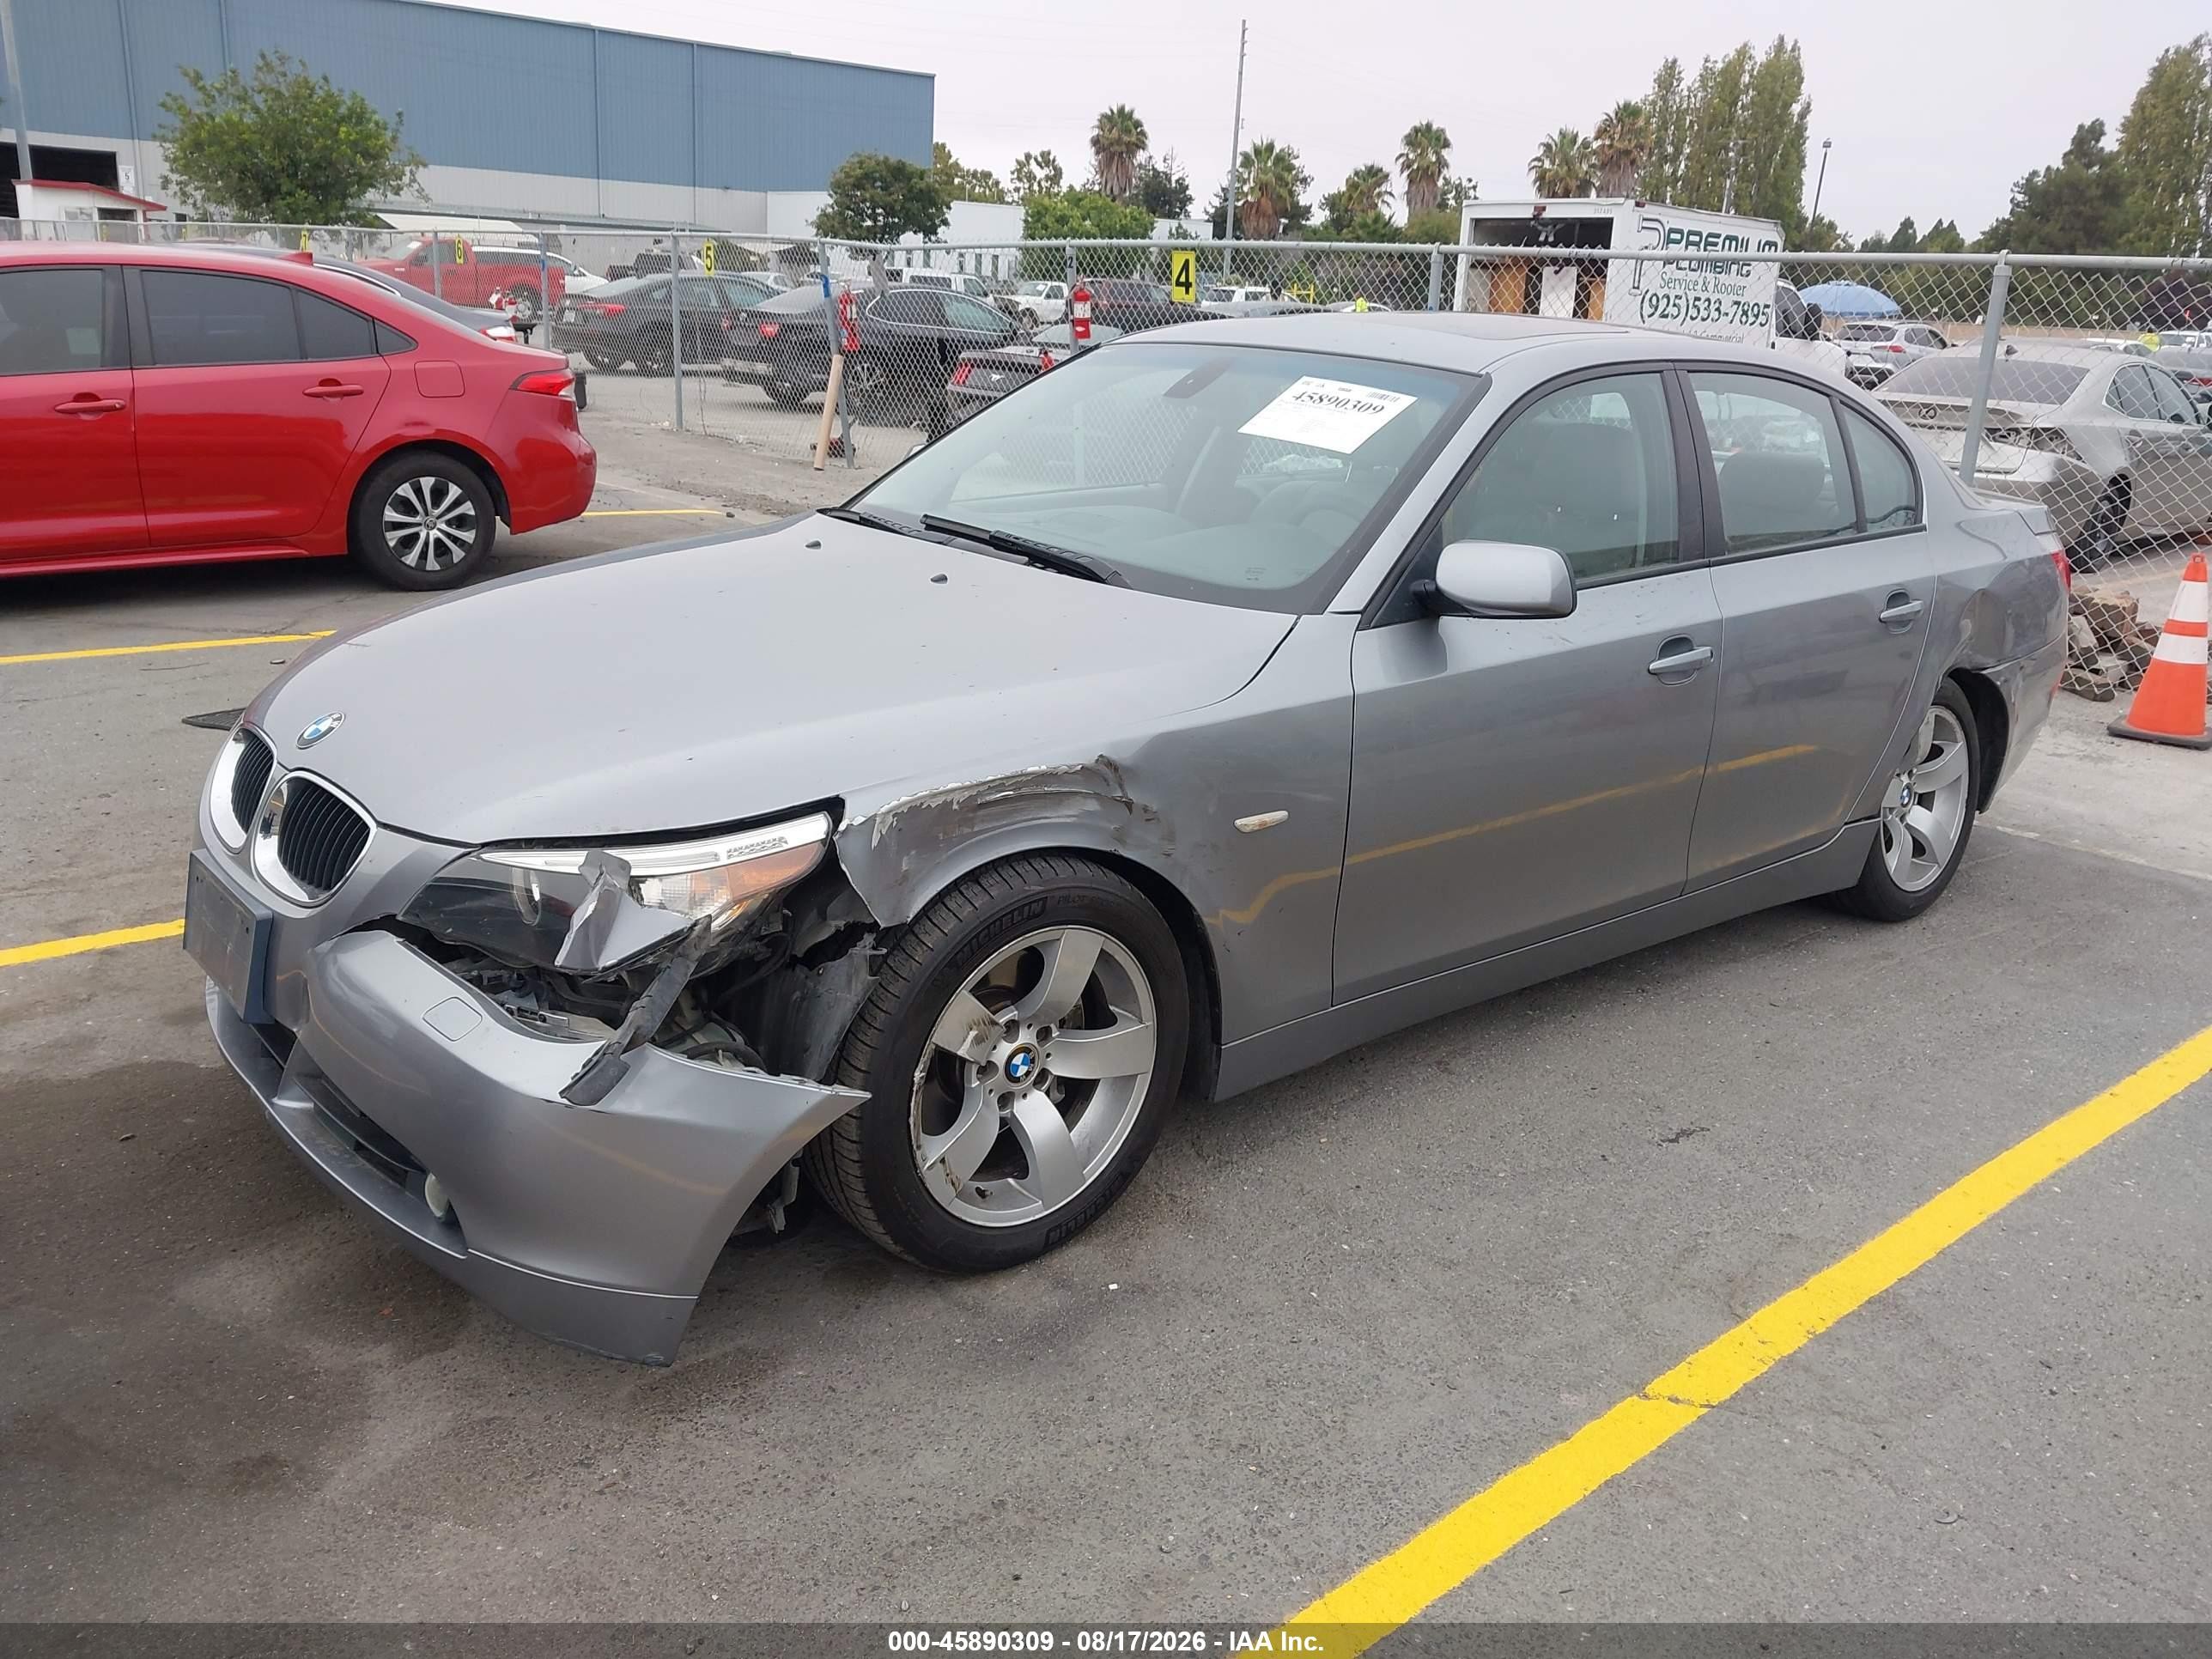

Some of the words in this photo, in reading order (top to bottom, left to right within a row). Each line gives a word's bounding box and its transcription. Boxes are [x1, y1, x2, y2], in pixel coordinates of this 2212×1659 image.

[125, 172, 130, 180] 5
[456, 240, 462, 259] 6
[1666, 227, 1778, 252] PREMIUM
[705, 246, 713, 271] 5
[1067, 256, 1074, 268] 2
[1175, 258, 1192, 295] 4
[1660, 270, 1698, 292] Service
[1701, 276, 1710, 293] &
[1713, 276, 1747, 297] Rooter
[1639, 288, 1771, 327] (925)533-7895
[1291, 391, 1385, 415] 45890309
[955, 898, 1045, 966] MICHELIN
